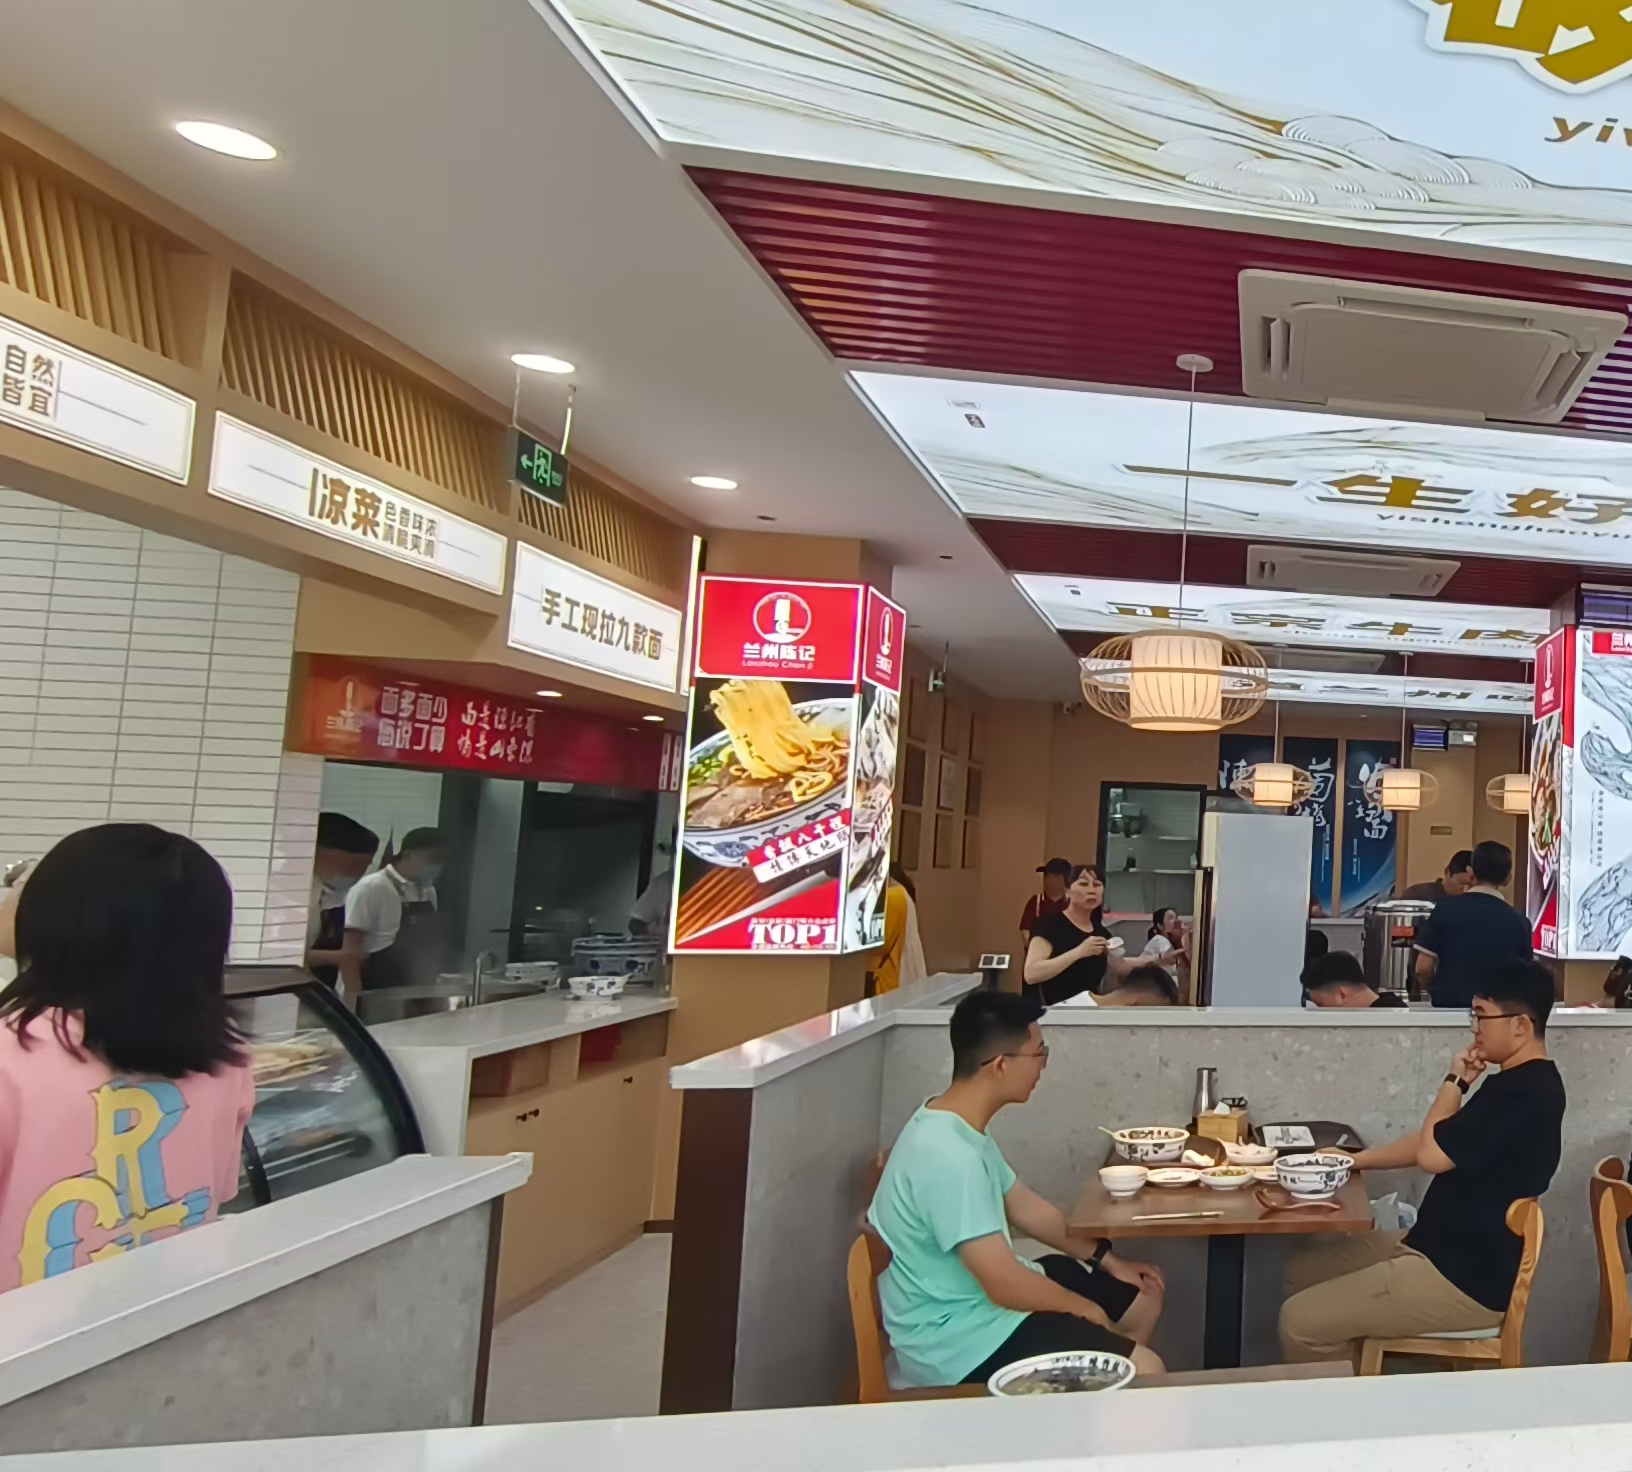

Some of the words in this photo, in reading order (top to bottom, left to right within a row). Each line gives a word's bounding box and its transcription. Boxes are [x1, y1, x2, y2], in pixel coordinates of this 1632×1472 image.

[4, 343, 55, 388] 自然
[2, 371, 53, 417] 皆宜
[317, 473, 383, 540] 凉菜
[541, 587, 664, 661] 手工现拉九款面
[742, 641, 816, 662] 兰州陈记
[747, 922, 837, 945] TOP1
